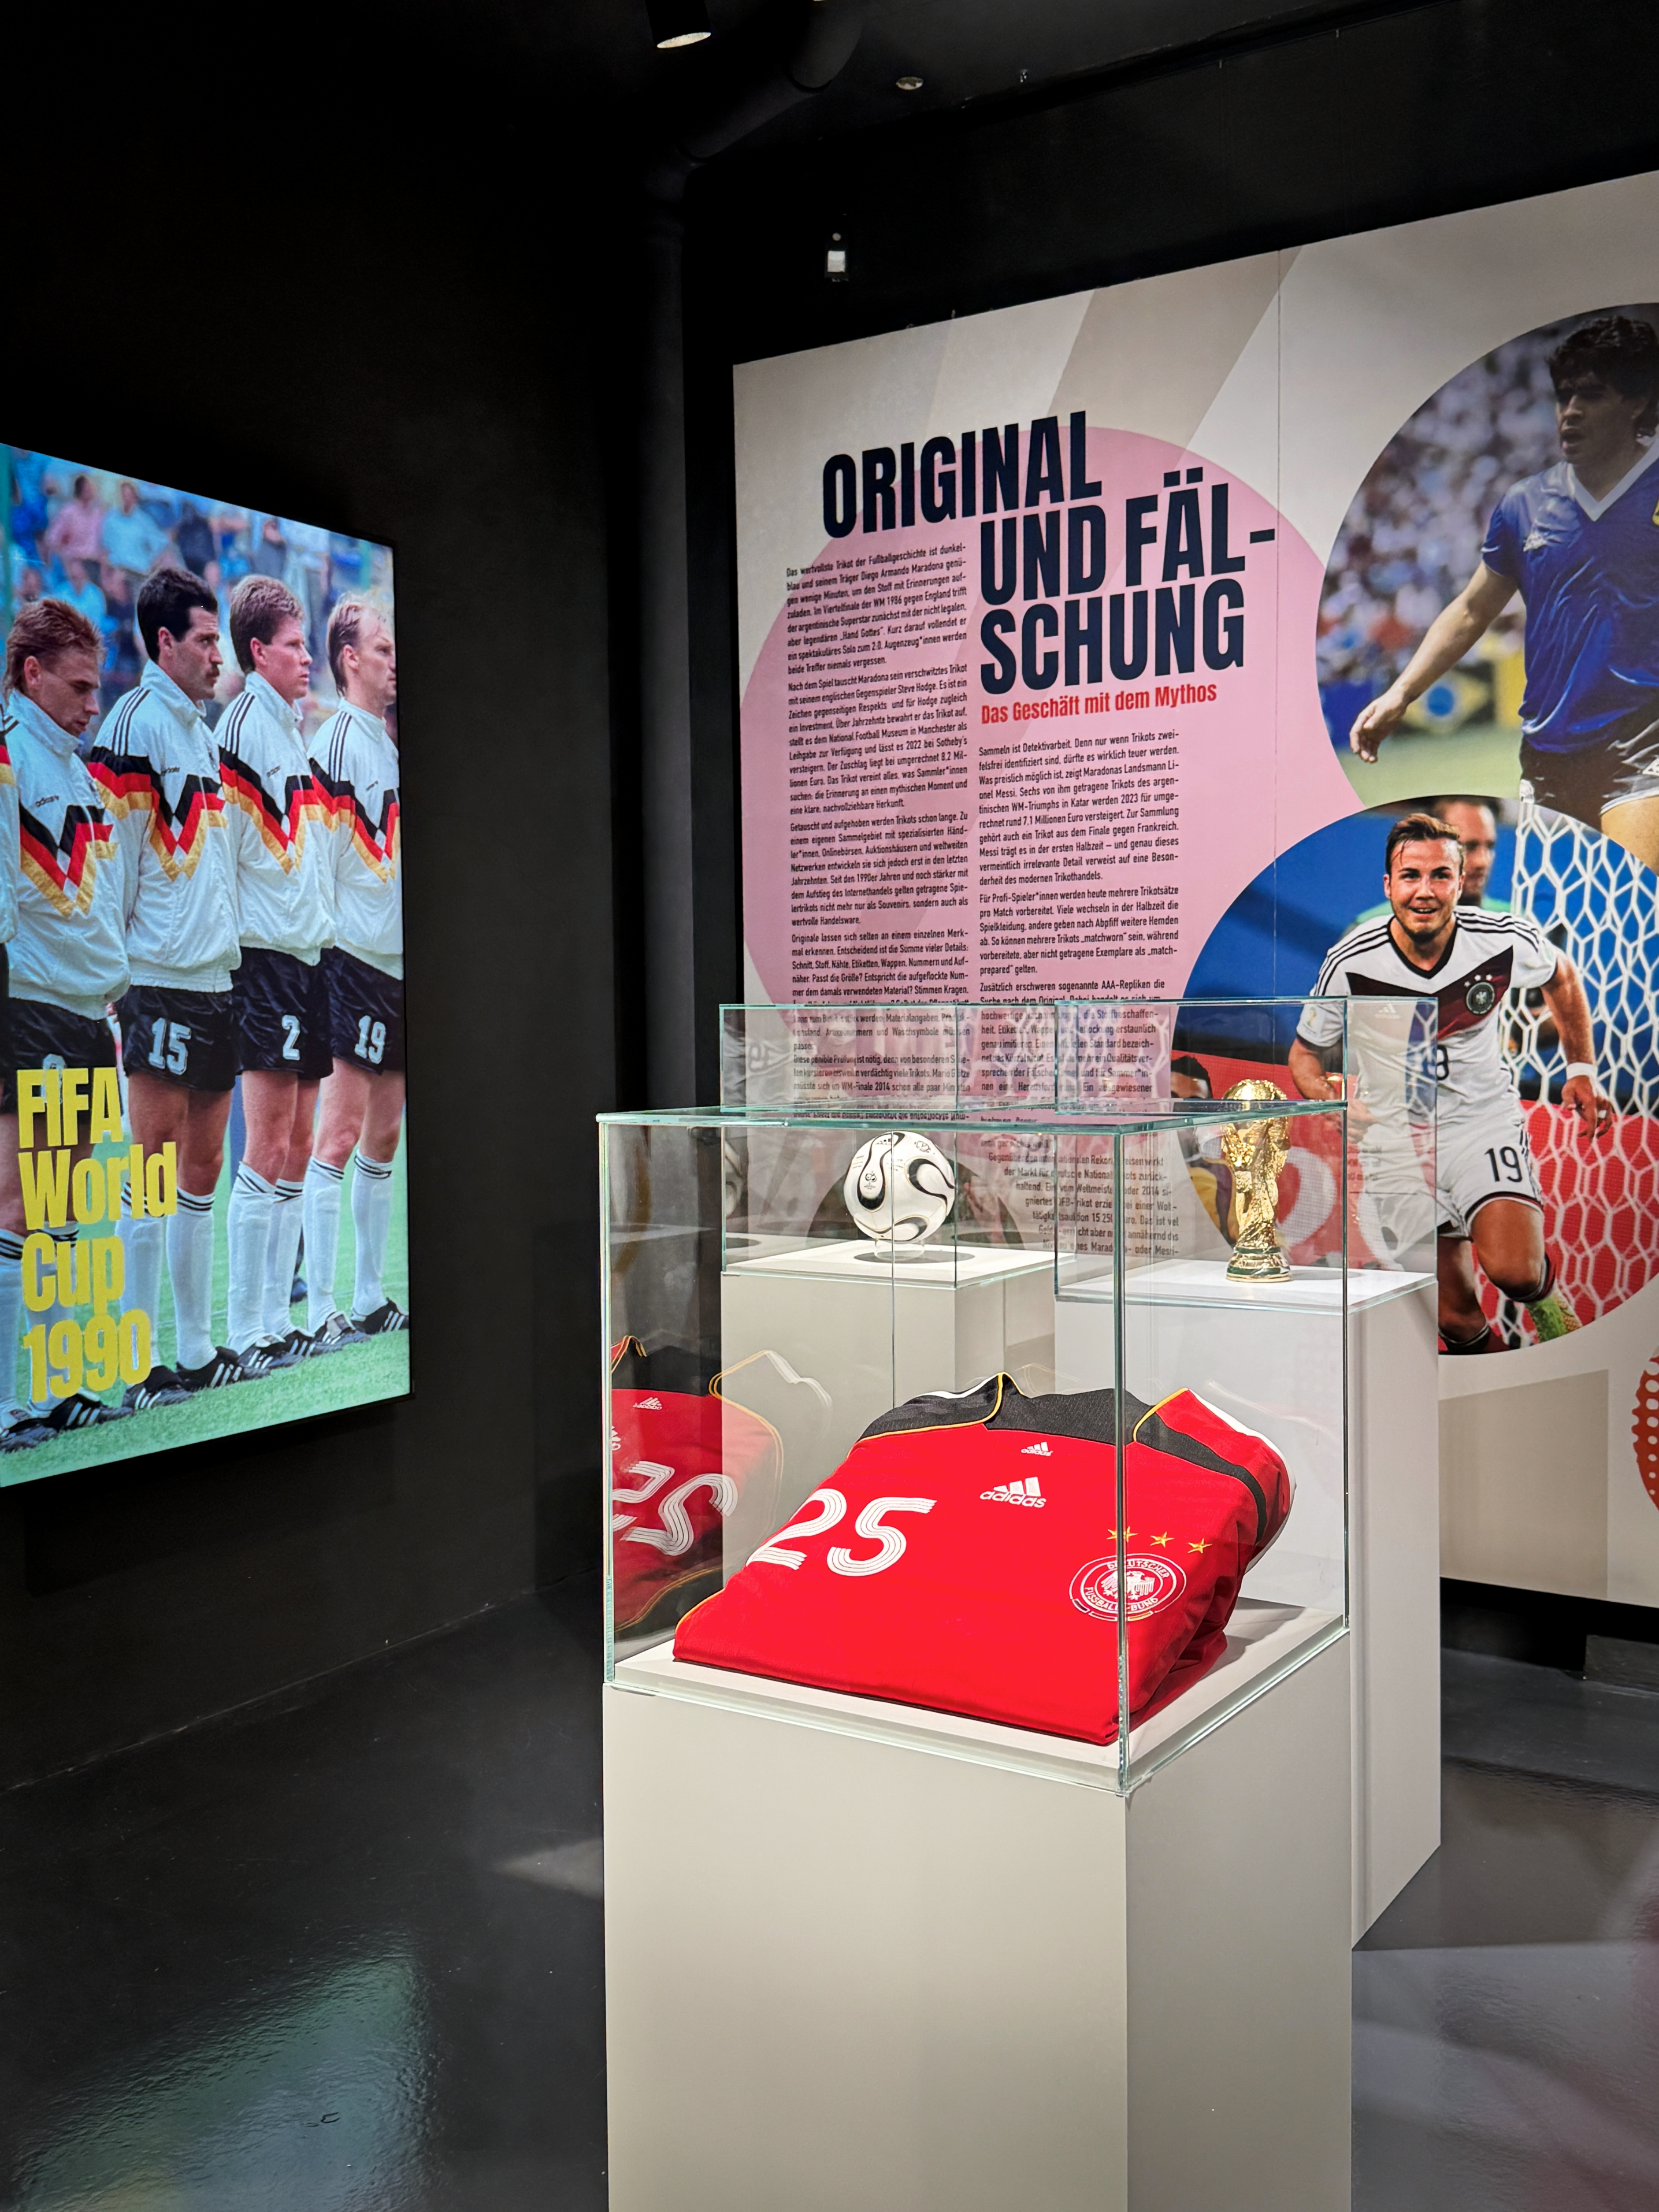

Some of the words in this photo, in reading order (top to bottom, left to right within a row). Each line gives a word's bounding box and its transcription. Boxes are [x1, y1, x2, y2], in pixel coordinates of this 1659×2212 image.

[823, 410, 1102, 538] ORIGINAL
[981, 505, 1106, 605] UND
[1126, 466, 1276, 587] FÄL-
[981, 579, 1244, 694] SCHUNG
[788, 681, 804, 691] Nach
[804, 681, 817, 690] dem
[818, 678, 834, 690] Spiel
[834, 676, 857, 687] tauscht
[857, 673, 889, 684] Maradona
[890, 670, 903, 680] sein
[904, 666, 948, 678] verschwitztes
[949, 663, 967, 674] Trikot
[980, 704, 1009, 725] Das
[1012, 694, 1080, 722] Geschäft
[1084, 692, 1111, 714] mit
[1114, 690, 1151, 711] dem
[1154, 683, 1217, 709] Mythos
[978, 744, 1010, 756] Sammeln
[1012, 744, 1021, 753] ist
[1022, 739, 1072, 752] Detektivarbeit.
[1074, 738, 1092, 748] Denn
[1094, 738, 1107, 746] nur
[1109, 736, 1129, 744] wenn
[1131, 732, 1155, 742] Trikots
[1158, 728, 1179, 740] zwei-
[979, 759, 1003, 771] felsfrei
[1004, 757, 1042, 768] identifiziert
[1063, 753, 1084, 764] dürfte
[1097, 749, 1126, 761] wirklich
[1128, 749, 1147, 758] teuer
[1149, 745, 1179, 756] werden.
[979, 789, 993, 800] onel
[995, 787, 1017, 798] Messi.
[1019, 786, 1040, 797] Sechs
[1057, 784, 1070, 793] ihm
[1073, 783, 1108, 795] getragene
[1111, 779, 1135, 790] Trikots
[1137, 777, 1151, 787] des
[1153, 777, 1179, 788] argen-
[979, 803, 1009, 814] tinischen
[1011, 799, 1060, 811] WM-Triumphs
[1061, 799, 1068, 808] in
[1070, 797, 1089, 807] Katar
[1091, 795, 1118, 806] werden
[1120, 793, 1138, 804] 2023
[1140, 792, 1151, 802] für
[1154, 792, 1179, 803] umge-
[790, 836, 809, 845] einem
[811, 835, 835, 846] eigenen
[838, 831, 882, 843] Sammelgebiet
[884, 829, 895, 839] mit
[898, 827, 944, 841] spezialisierten
[947, 824, 968, 835] Händ-
[979, 832, 1001, 845] gehört
[1003, 831, 1019, 841] auch
[1022, 830, 1032, 840] ein
[1034, 829, 1054, 839] Trikot
[1070, 827, 1086, 837] dem
[1089, 825, 1110, 836] Finale
[1112, 826, 1135, 837] gegen
[1137, 820, 1179, 833] Frankreich.
[979, 860, 1021, 871] vermeintlich
[1023, 858, 1060, 869] irrelevante
[1063, 856, 1083, 867] Detail
[1085, 854, 1116, 865] verweist
[1118, 853, 1130, 864] auf
[1133, 853, 1149, 863] eine
[1151, 852, 1178, 862] Beson-
[979, 875, 1003, 886] derheit
[1004, 875, 1017, 884] des
[1018, 874, 1053, 884] modernen
[1054, 870, 1103, 882] Trikothandels.
[979, 893, 991, 903] Für
[1059, 889, 1085, 900] werden
[1087, 888, 1107, 898] heute
[1108, 887, 1139, 897] mehrere
[1140, 885, 1179, 896] Trikotsätze
[979, 910, 991, 920] pro
[993, 907, 1013, 917] Match
[1015, 905, 1054, 916] vorbereitet.
[1056, 904, 1074, 914] Viele
[1076, 903, 1109, 914] wechseln
[1112, 902, 1119, 912] in
[1121, 902, 1133, 912] der
[1136, 900, 1165, 911] Halbzeit
[1167, 900, 1179, 910] die
[791, 933, 819, 945] Originale
[821, 933, 842, 942] lassen
[843, 932, 857, 941] sich
[859, 931, 879, 941] selten
[891, 930, 911, 939] einem
[913, 929, 945, 939] einzelnen
[947, 928, 968, 938] Merk-
[791, 947, 804, 956] mal
[836, 945, 878, 955] Entscheidend
[879, 945, 887, 954] ist
[888, 944, 898, 953] die
[899, 944, 924, 953] Summe
[925, 943, 943, 952] vieler
[979, 936, 990, 946] ab.
[991, 936, 1000, 946] So
[1000, 936, 1025, 945] können
[1026, 934, 1056, 945] mehrere
[1056, 933, 1080, 943] Trikots
[1146, 929, 1178, 940] während
[812, 973, 828, 982] Passt
[830, 973, 840, 982] die
[841, 972, 863, 982] Größe?
[864, 972, 896, 983] Entspricht
[897, 971, 907, 981] die
[908, 970, 948, 983] aufgeflockte
[950, 970, 969, 980] Num-
[979, 982, 1013, 992] Zusätzlich
[1015, 981, 1056, 991] erschweren
[1058, 981, 1098, 993] sogenannte
[1101, 979, 1151, 991] AAA-Repliken
[1153, 979, 1165, 989] die
[805, 987, 819, 996] dem
[819, 986, 842, 996] damals
[843, 986, 883, 996] verwendeten
[883, 985, 913, 995] Material?
[914, 984, 942, 994] Stimmen
[149, 1017, 191, 1075] 15
[282, 1015, 300, 1060] 2
[354, 1015, 386, 1064] 19
[17, 1068, 124, 1149] FIFA
[1484, 1146, 1523, 1182] 19
[19, 1142, 177, 1231] World
[22, 1233, 125, 1315] Cup
[23, 1309, 151, 1401] 1990
[980, 1491, 1046, 1508] adidas
[745, 1488, 937, 1577] 25
